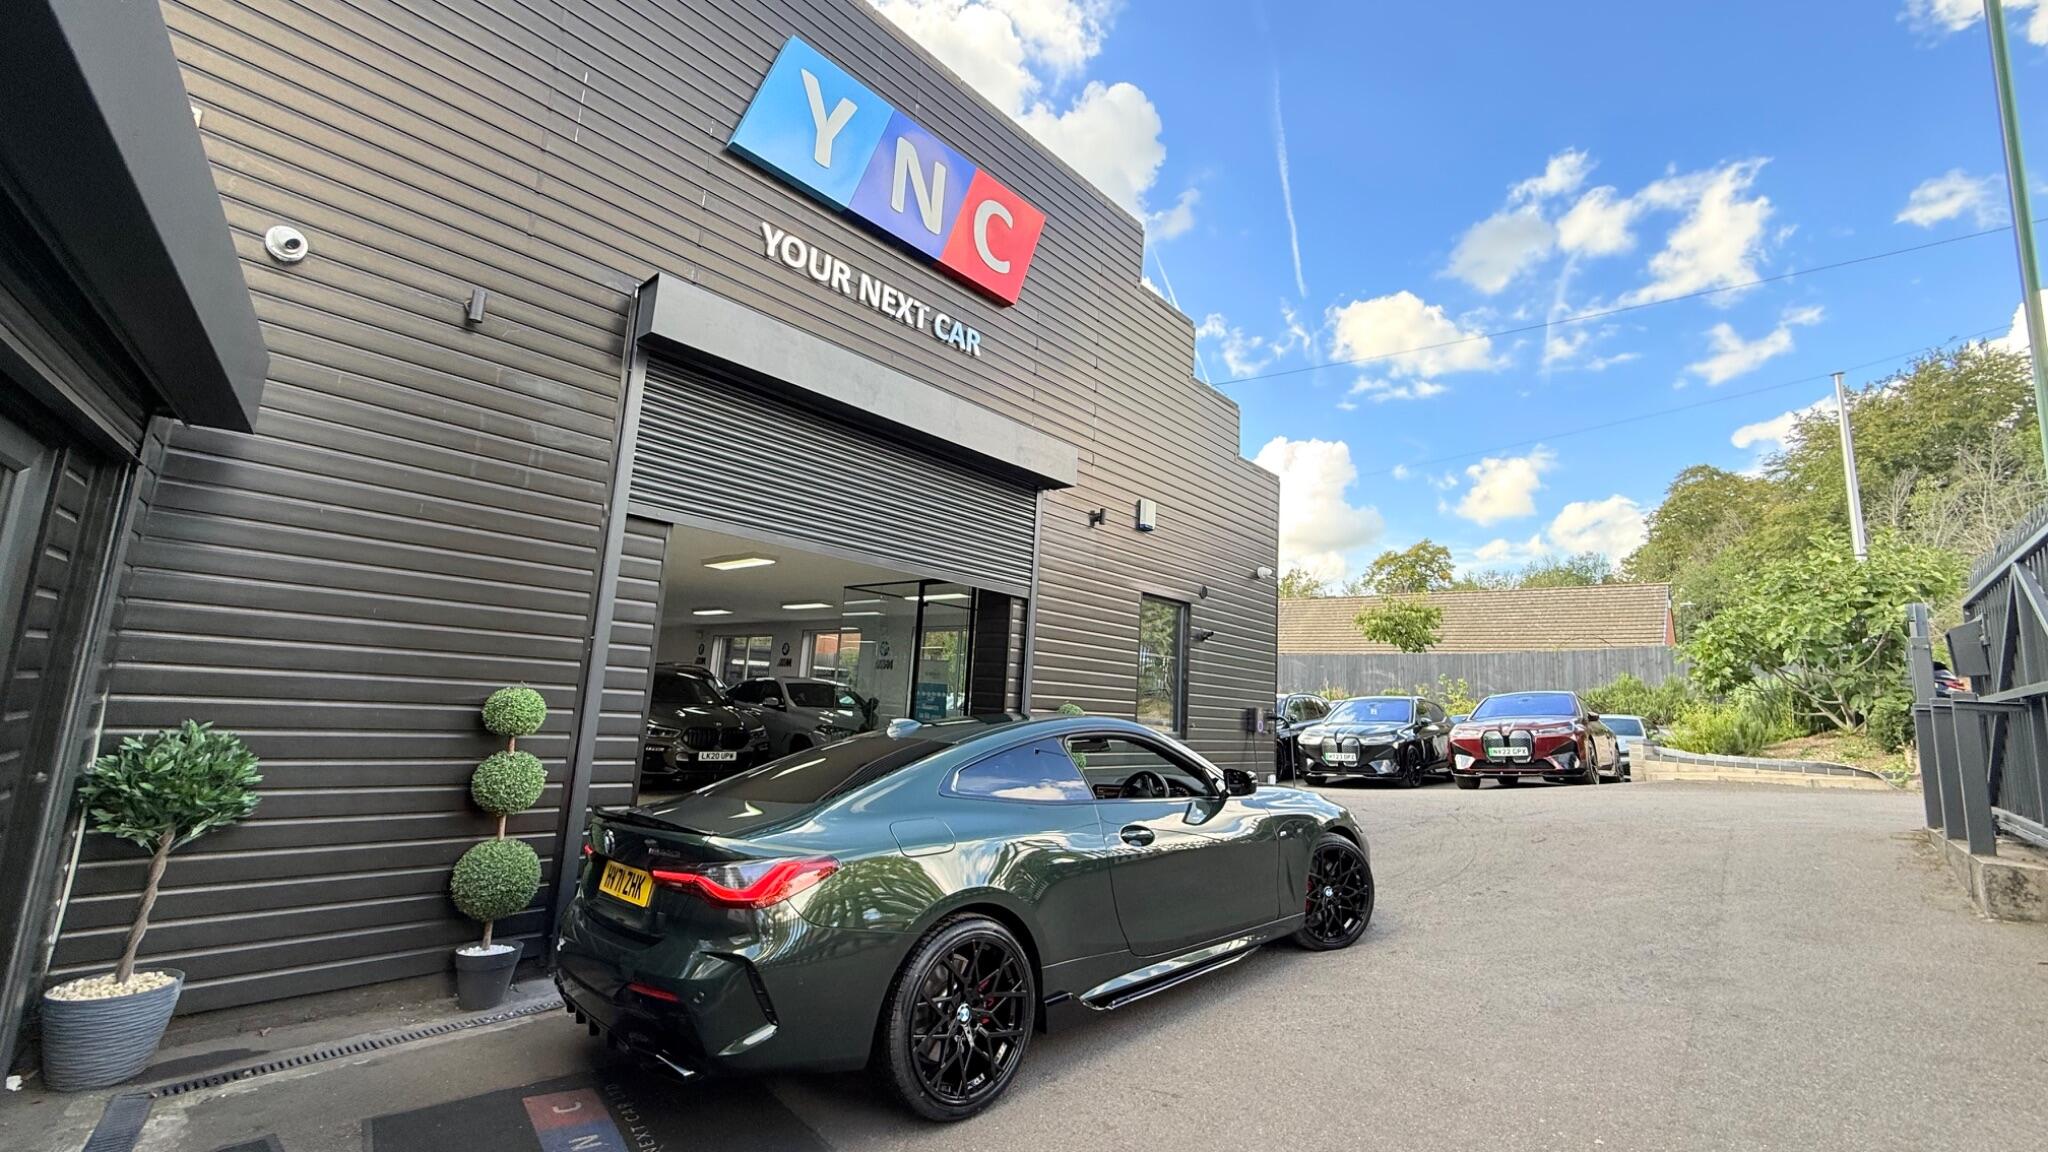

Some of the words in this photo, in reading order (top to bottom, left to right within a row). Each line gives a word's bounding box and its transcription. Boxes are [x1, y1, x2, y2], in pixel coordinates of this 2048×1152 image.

[801, 68, 1014, 274] YNC
[761, 222, 852, 294] YOUR
[859, 273, 930, 329] NEXT
[934, 313, 982, 357] CAR
[623, 871, 646, 899] ZHK
